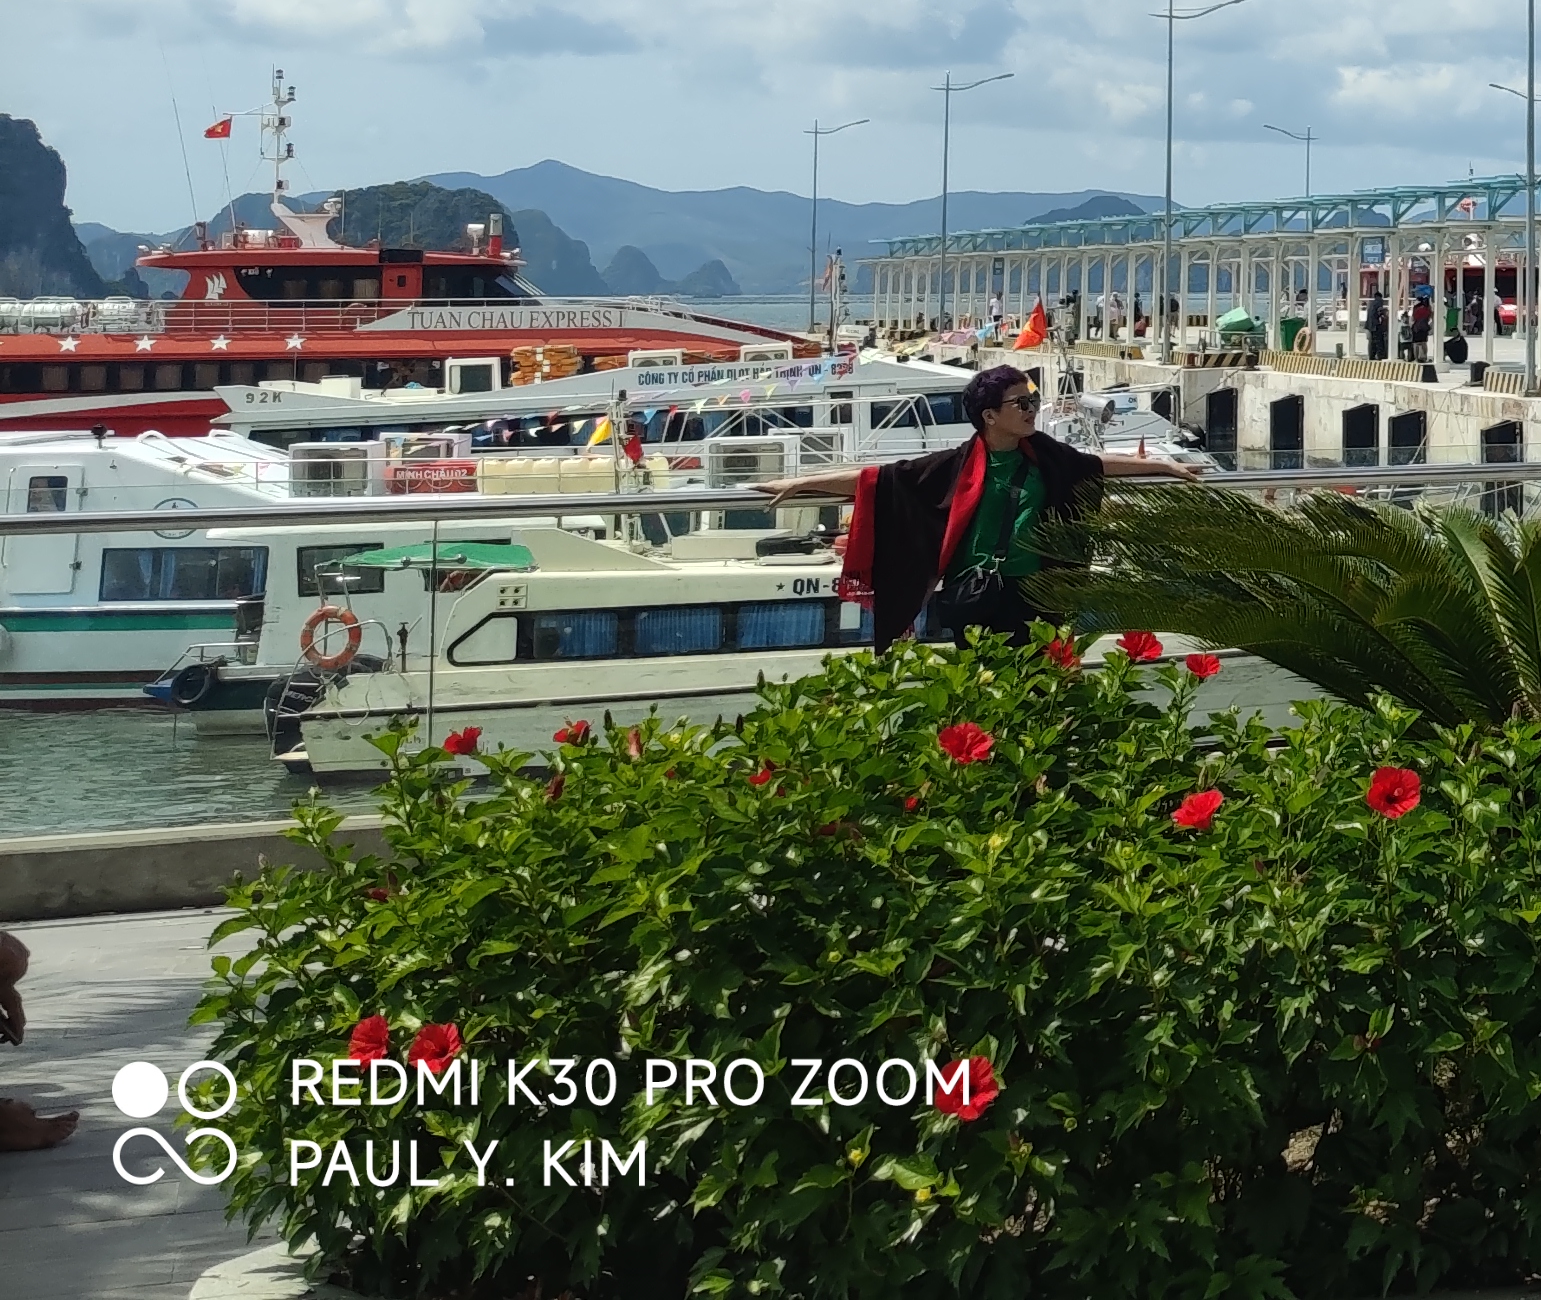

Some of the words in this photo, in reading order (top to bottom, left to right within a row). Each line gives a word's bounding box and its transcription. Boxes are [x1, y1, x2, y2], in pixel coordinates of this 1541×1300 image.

[408, 311, 461, 329] TUAN
[467, 311, 523, 329] CHAU
[529, 310, 613, 328] EXPRESS
[638, 371, 664, 385] CÔNG
[667, 372, 679, 384] TY
[681, 366, 694, 383] CỔ
[697, 366, 723, 382] PHẦN
[245, 392, 282, 403] 92K
